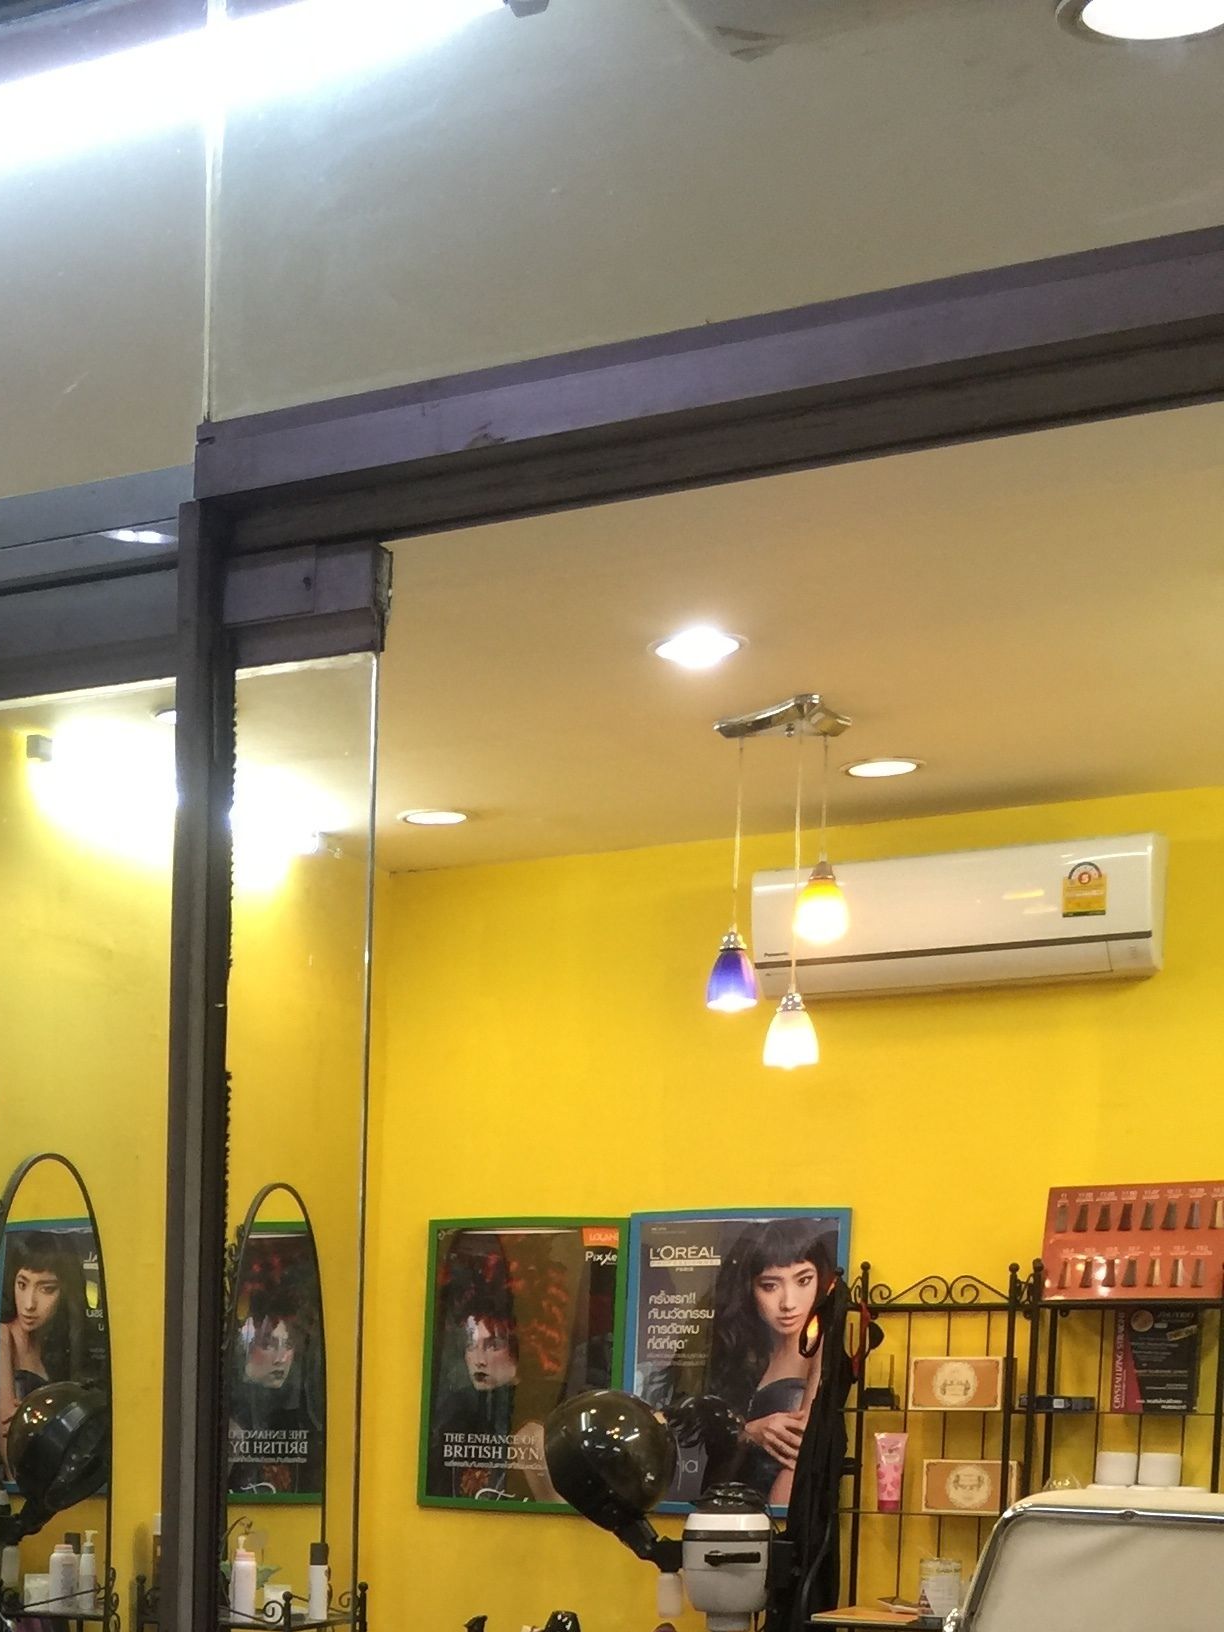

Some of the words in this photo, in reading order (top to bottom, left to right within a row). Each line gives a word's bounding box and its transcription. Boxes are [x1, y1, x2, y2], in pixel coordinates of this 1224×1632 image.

[649, 1245, 721, 1260] L'ORÉAL
[443, 1433, 464, 1443] THE
[467, 1434, 519, 1444] ENHANCE
[443, 1445, 502, 1459] BRITISH
[507, 1446, 544, 1460] DYN
